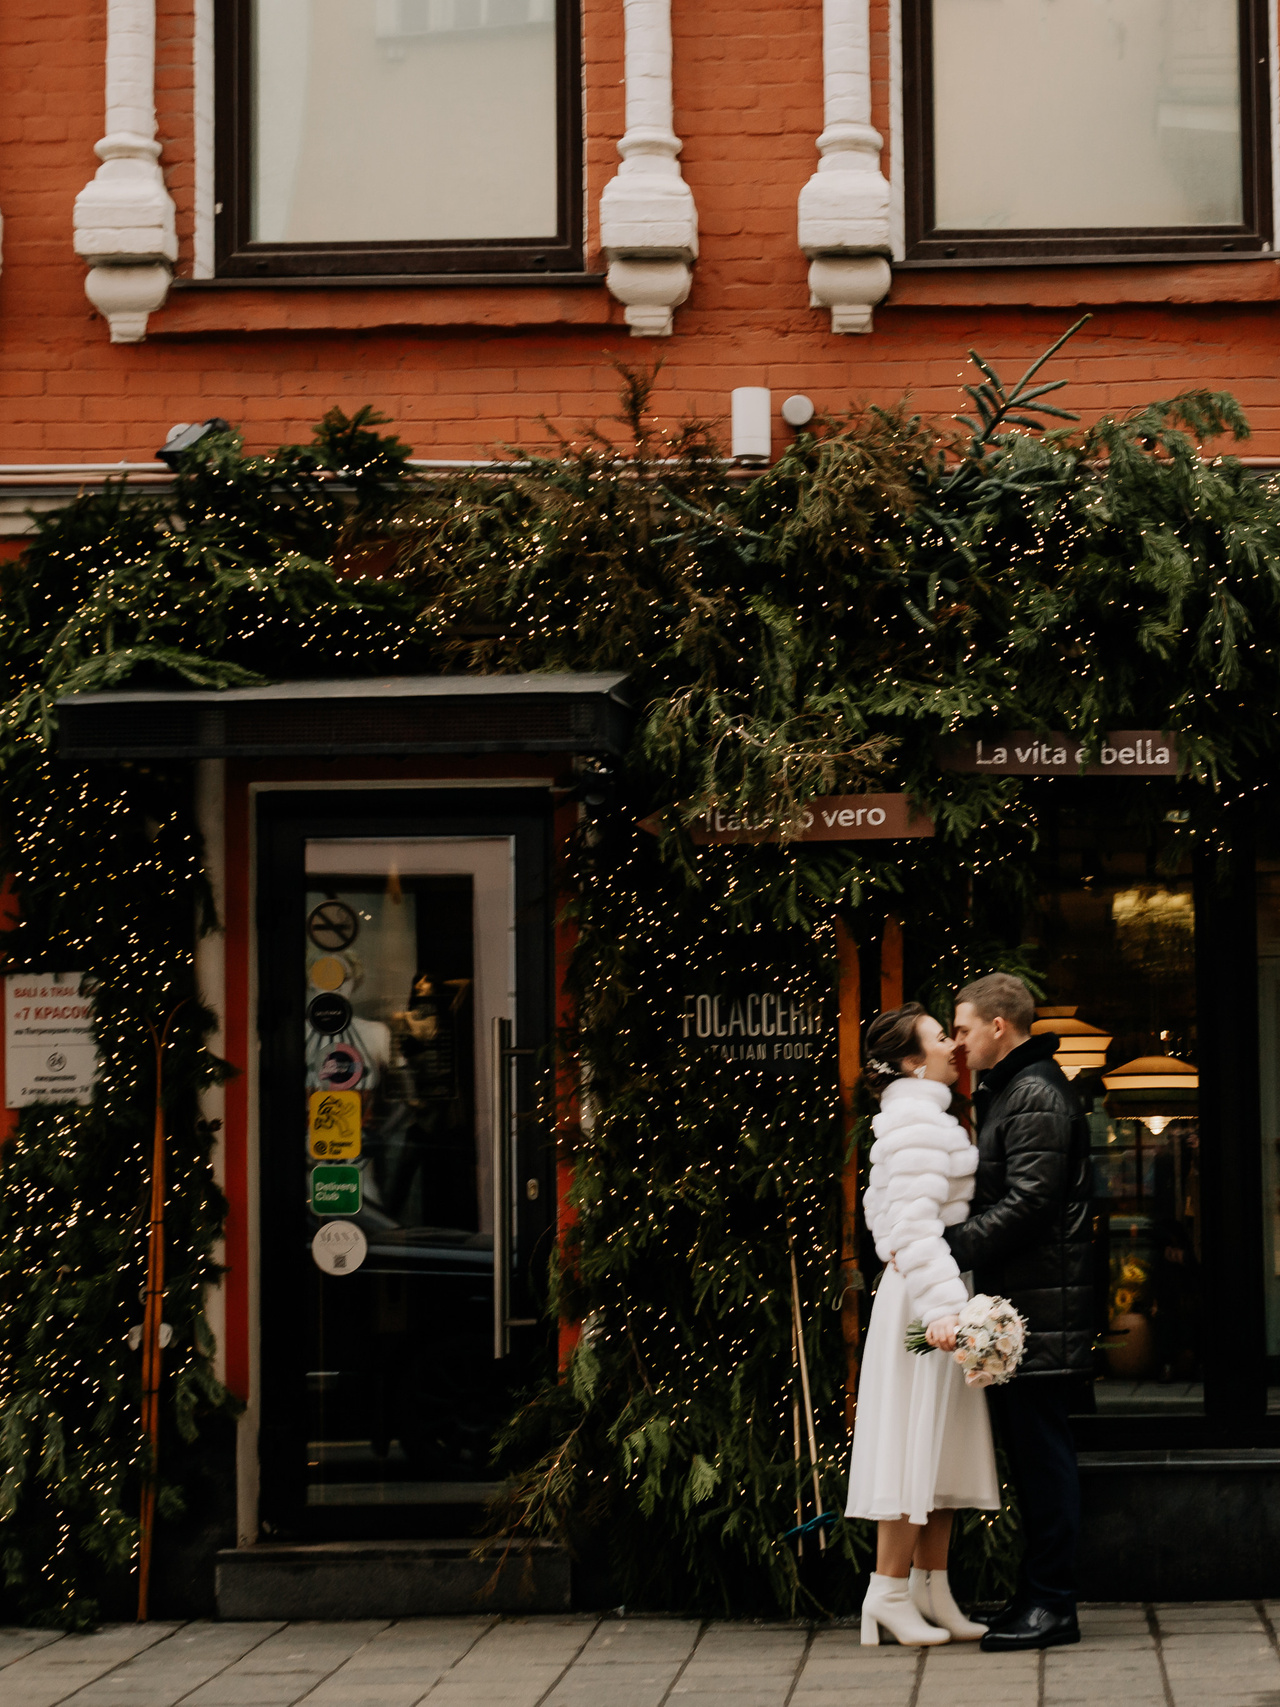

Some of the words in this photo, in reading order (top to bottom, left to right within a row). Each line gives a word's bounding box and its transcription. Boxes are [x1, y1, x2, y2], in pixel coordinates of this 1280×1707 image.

[976, 739, 1007, 765] La
[1014, 740, 1067, 765] vita
[1101, 739, 1170, 765] bella
[821, 807, 887, 828] vero
[704, 1043, 767, 1062] TALIAN
[315, 1181, 357, 1193] Delivery
